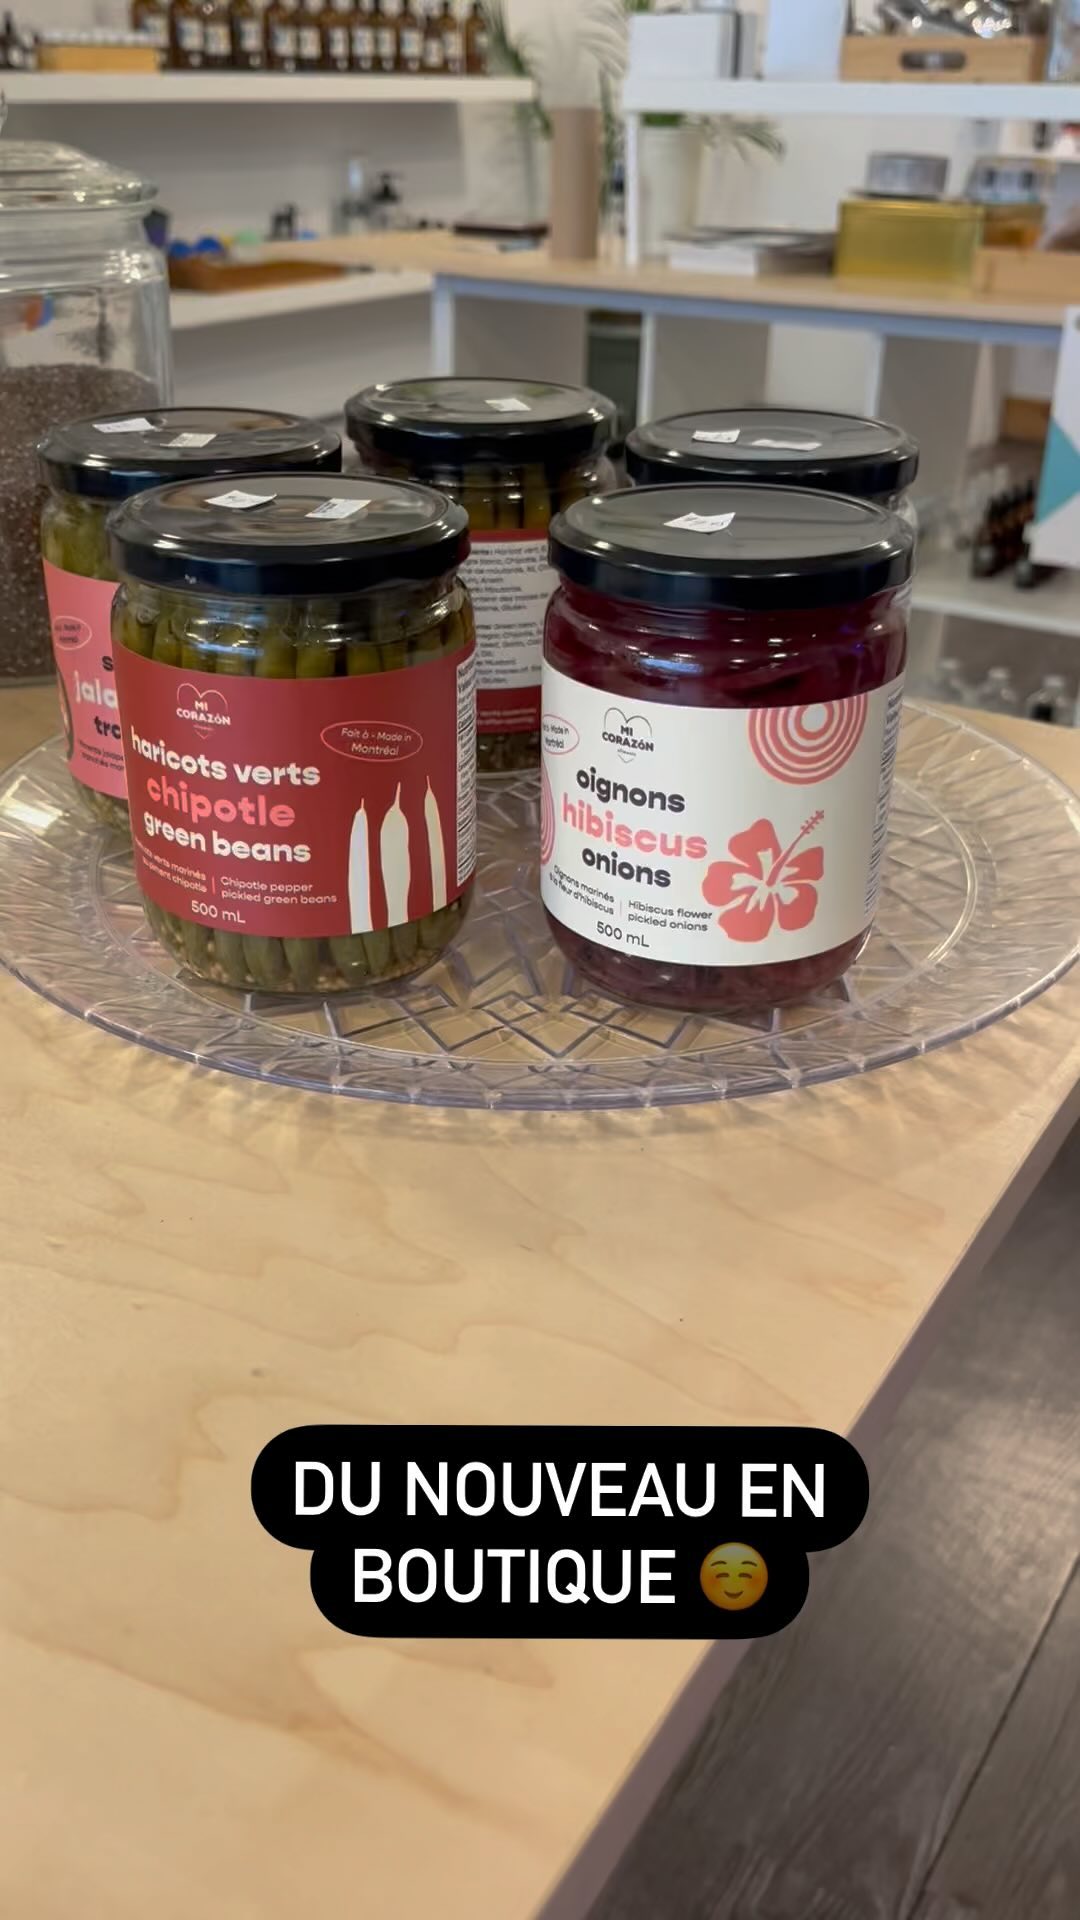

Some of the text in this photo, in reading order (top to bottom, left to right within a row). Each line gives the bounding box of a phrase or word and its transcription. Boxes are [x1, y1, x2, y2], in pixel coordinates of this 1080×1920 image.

[194, 700, 208, 711] MI
[176, 707, 231, 725] CORAZÓN
[341, 727, 361, 739] Fait
[377, 732, 402, 742] Made
[404, 734, 412, 742] in
[620, 725, 634, 737] MI
[351, 742, 399, 756] Montréal
[602, 731, 654, 752] CORAZÓN
[130, 725, 228, 780] haricots
[233, 762, 321, 786] verts
[576, 766, 685, 813] oignons
[147, 775, 296, 828] chipotle
[562, 792, 708, 859] hibiscus
[143, 811, 206, 852] green
[212, 830, 312, 862] beans
[582, 848, 671, 888] onions
[172, 875, 207, 893] chipotle
[220, 876, 313, 893] Chipotle pepper
[554, 865, 614, 903] Oignons marinés
[221, 890, 338, 905] pickled green beans
[191, 900, 246, 924] 500 mL
[628, 900, 713, 920] Hibiscus flower
[628, 912, 708, 932] pickled onions
[596, 921, 650, 948] 500 mL
